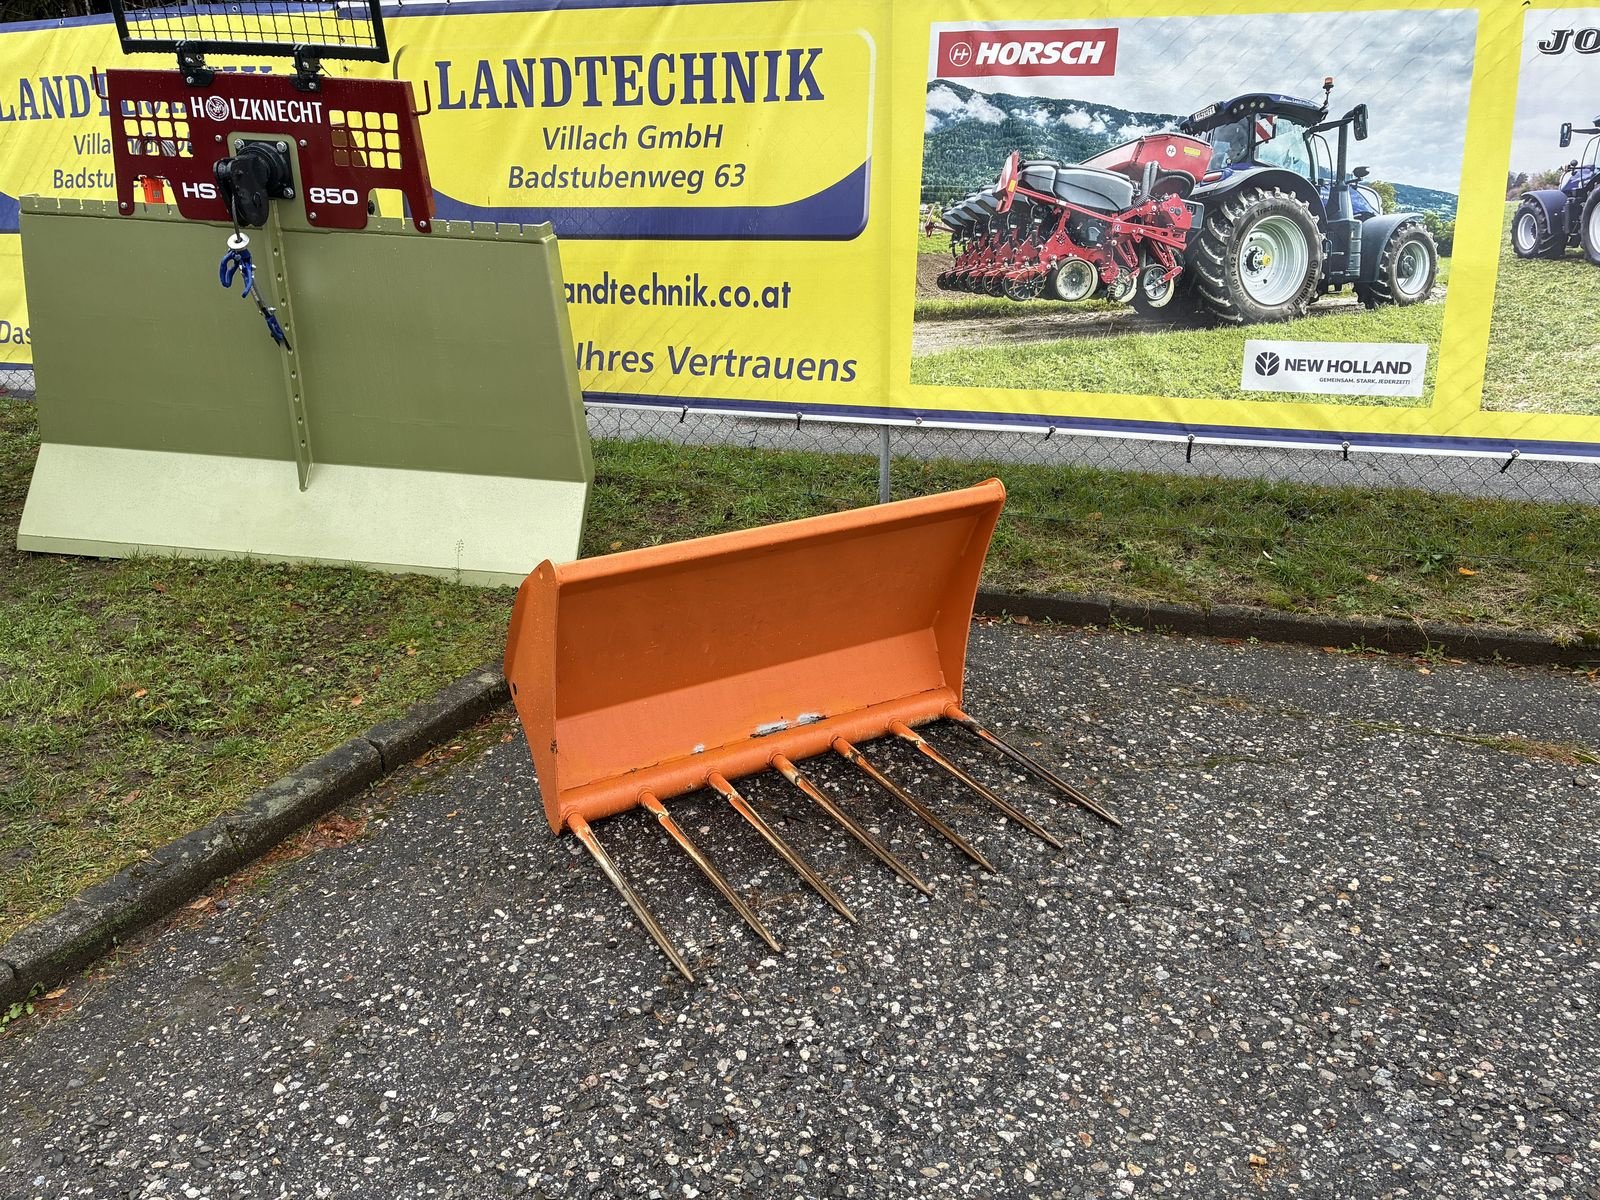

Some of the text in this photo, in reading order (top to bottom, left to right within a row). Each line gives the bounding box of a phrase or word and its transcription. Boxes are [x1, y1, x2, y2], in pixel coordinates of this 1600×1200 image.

[976, 41, 1106, 66] HORSCH
[435, 48, 824, 110] LANDTECHNIK
[73, 133, 111, 155] Villa
[542, 123, 724, 151] Villach GmbH
[53, 167, 114, 189] Badstu
[508, 164, 746, 194] Badstubenweg 63
[182, 182, 358, 205] HS 850
[576, 340, 857, 383] Ihres Vertrauens
[1285, 358, 1412, 375] NEW HOLLAND
